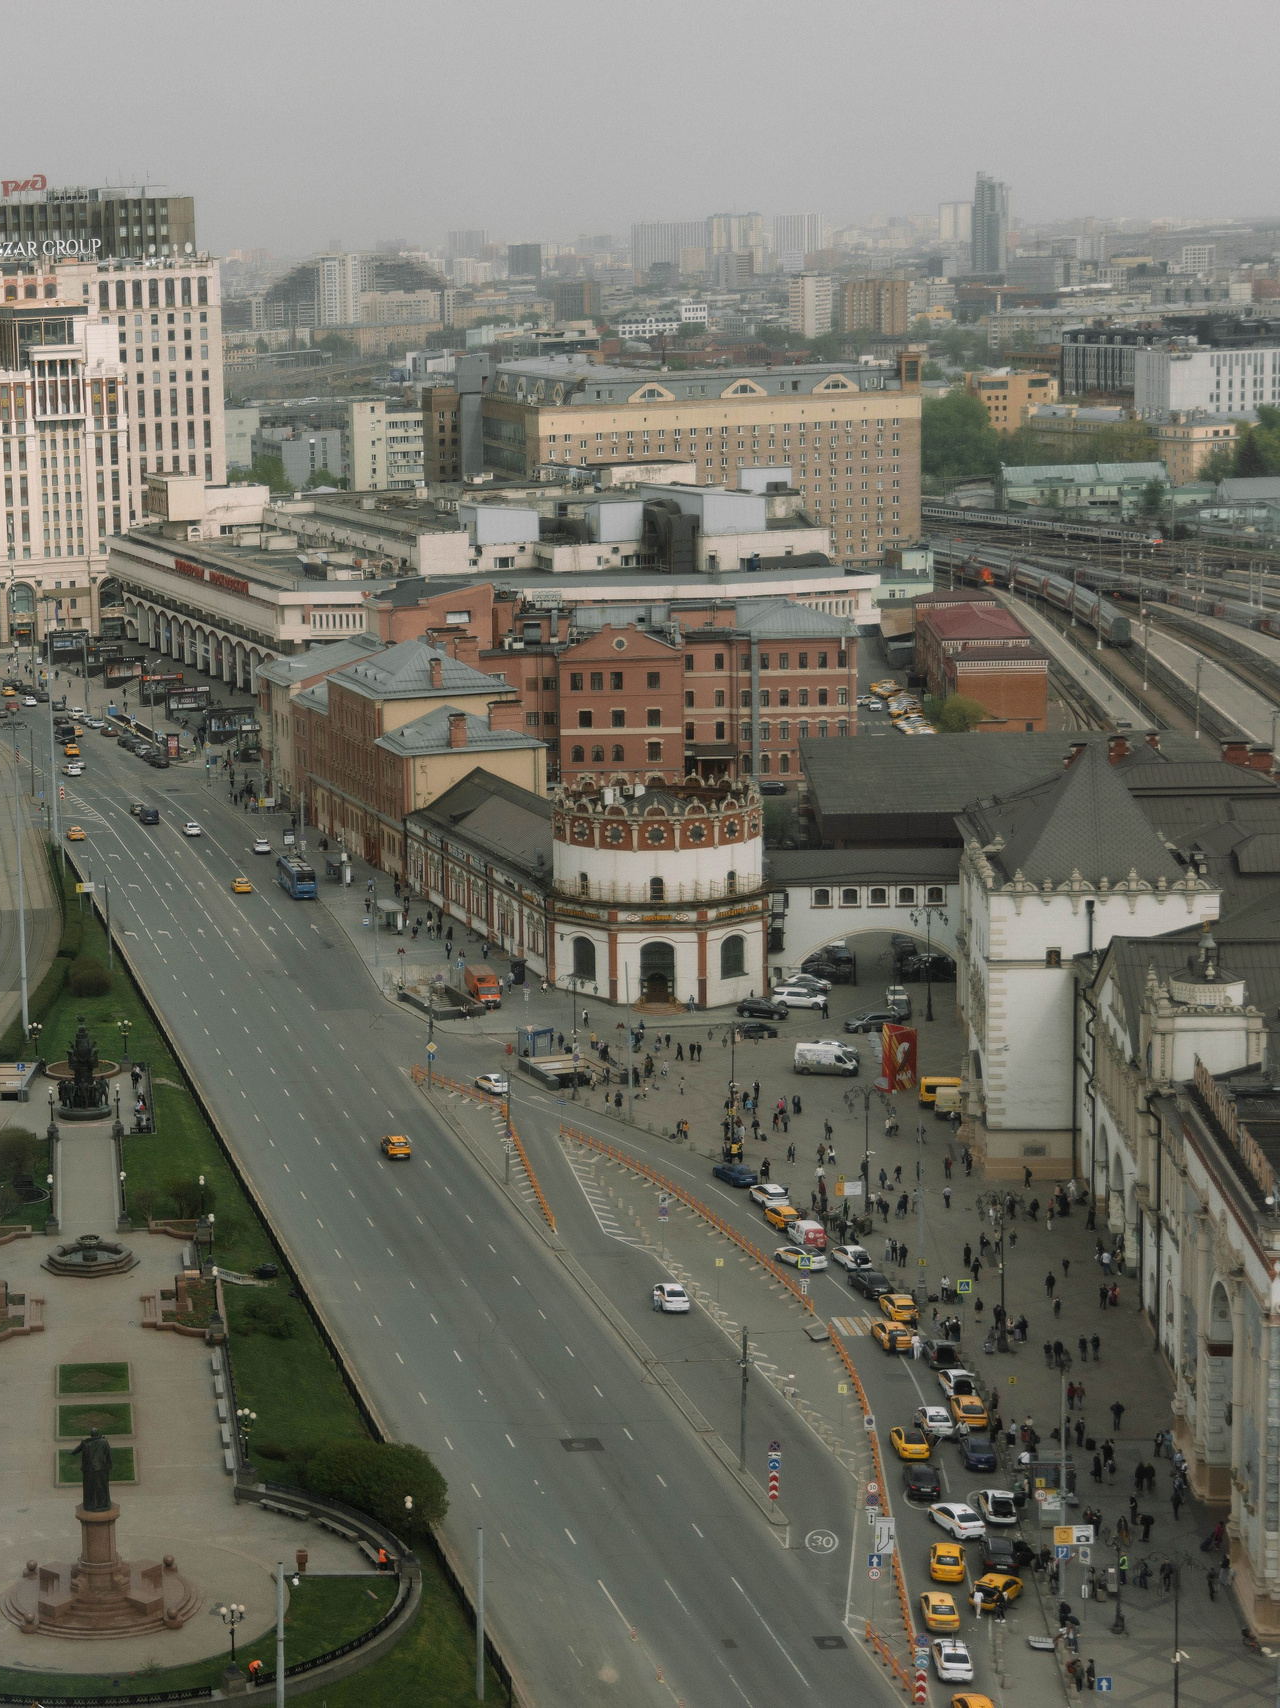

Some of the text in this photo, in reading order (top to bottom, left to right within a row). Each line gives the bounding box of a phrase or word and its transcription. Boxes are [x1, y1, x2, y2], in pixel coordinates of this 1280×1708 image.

[42, 238, 102, 257] GROUP
[896, 1070, 912, 1081] МАЯ
[811, 1535, 834, 1548] 30
[870, 1570, 879, 1578] 30
